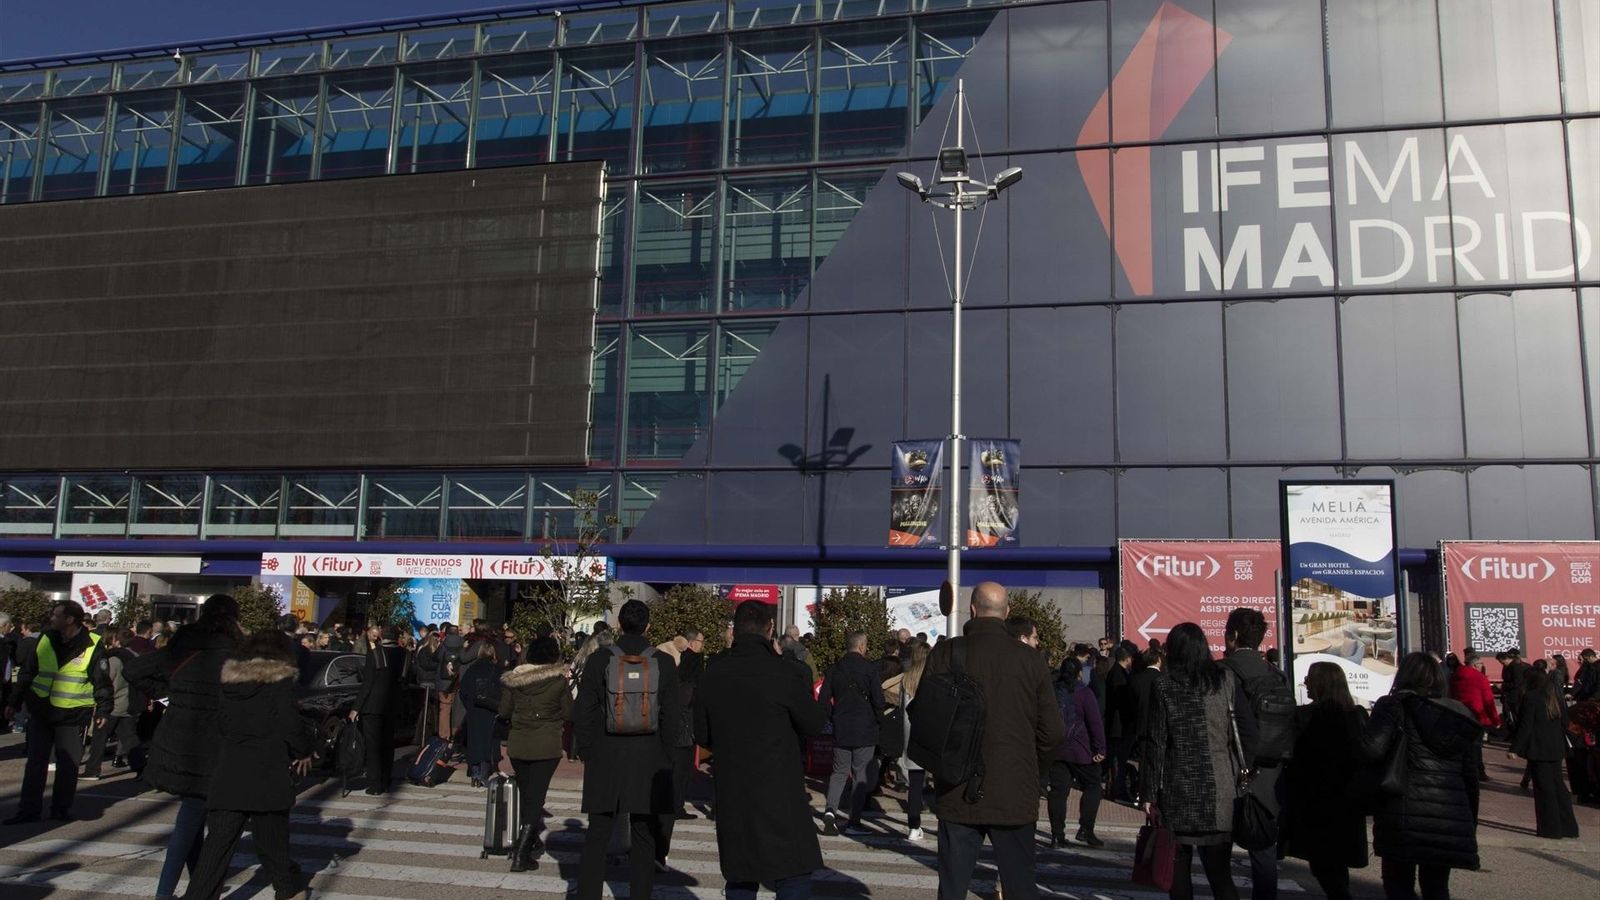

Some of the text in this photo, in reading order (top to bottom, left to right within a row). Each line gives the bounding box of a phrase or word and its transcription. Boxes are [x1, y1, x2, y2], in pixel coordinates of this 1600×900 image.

[1182, 134, 1496, 213] IFEMA
[1183, 211, 1592, 292] MADRID
[1300, 515, 1380, 524] AVENIDA AMÉRICA
[61, 559, 152, 569] Puerta Sur South Entrance
[322, 557, 354, 572] Fitur
[396, 558, 462, 567] BIENVENIDOS
[501, 559, 535, 575] Fitur
[1153, 555, 1206, 577] Fitur
[1480, 556, 1539, 579] Fitur
[405, 567, 452, 576] WELCOME
[1200, 596, 1239, 604] ACCESO
[1542, 617, 1596, 628] ONLINE
[1543, 636, 1593, 647] ONLINE
